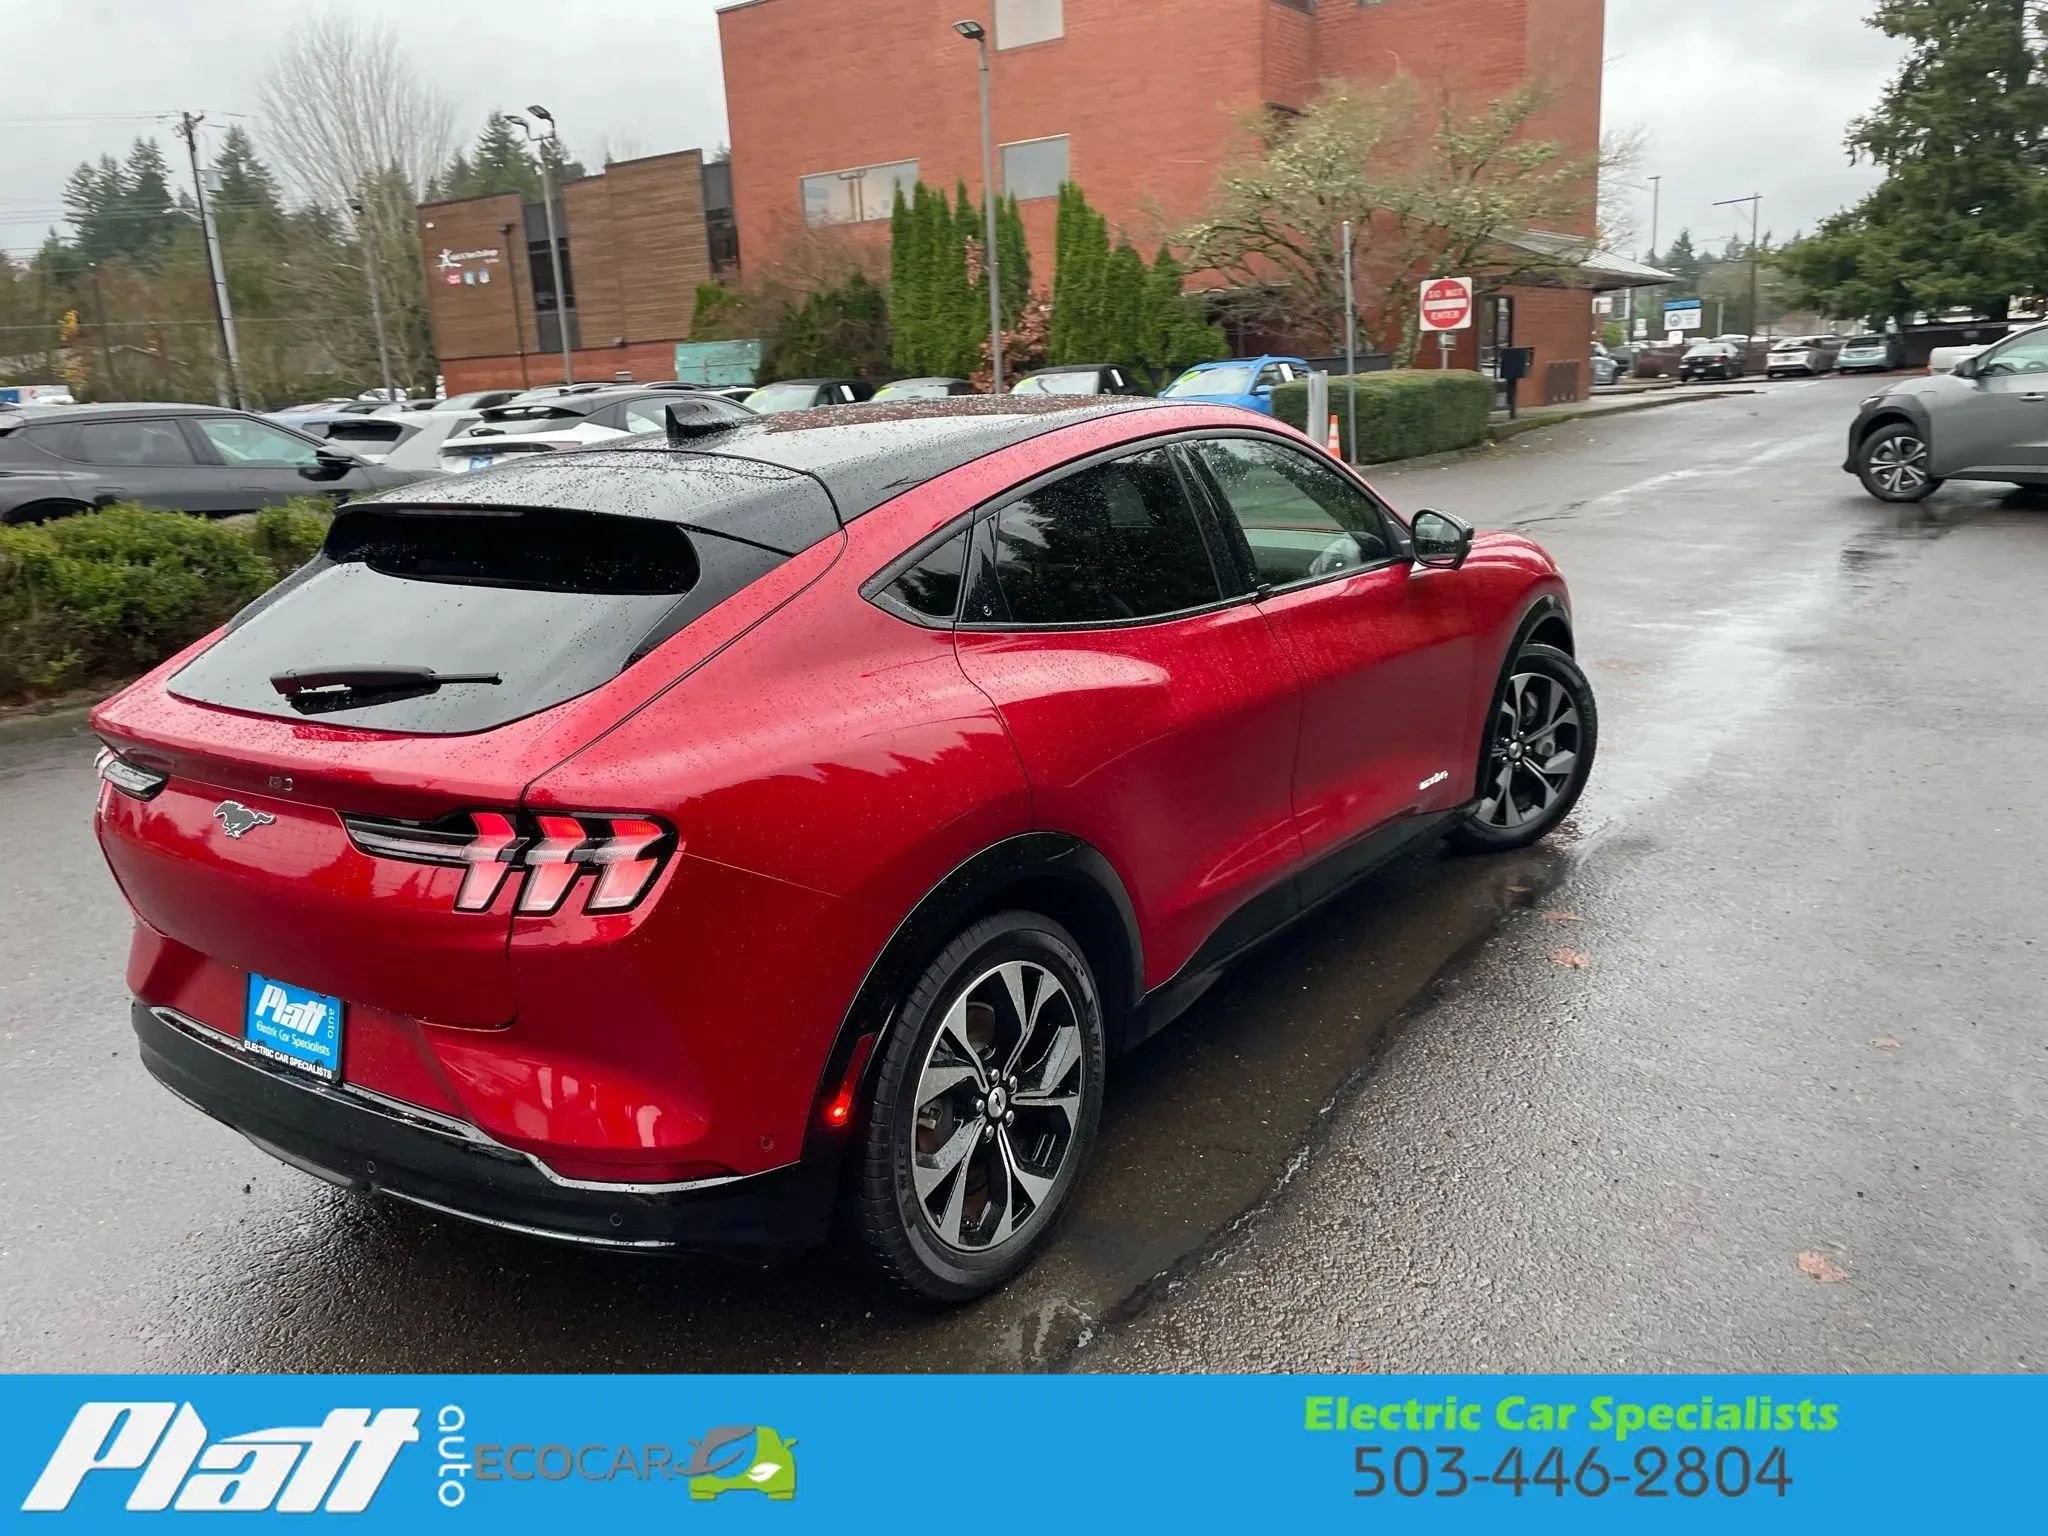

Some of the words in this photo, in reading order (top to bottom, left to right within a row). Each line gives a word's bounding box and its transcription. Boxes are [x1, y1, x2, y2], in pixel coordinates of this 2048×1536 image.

[327, 1007, 335, 1039] auto
[279, 1029, 290, 1042] Car
[292, 1033, 330, 1056] Specialists
[244, 1040, 274, 1058] ELECTRIC
[274, 1051, 289, 1064] CAR
[289, 1056, 333, 1079] SPECIALISTS
